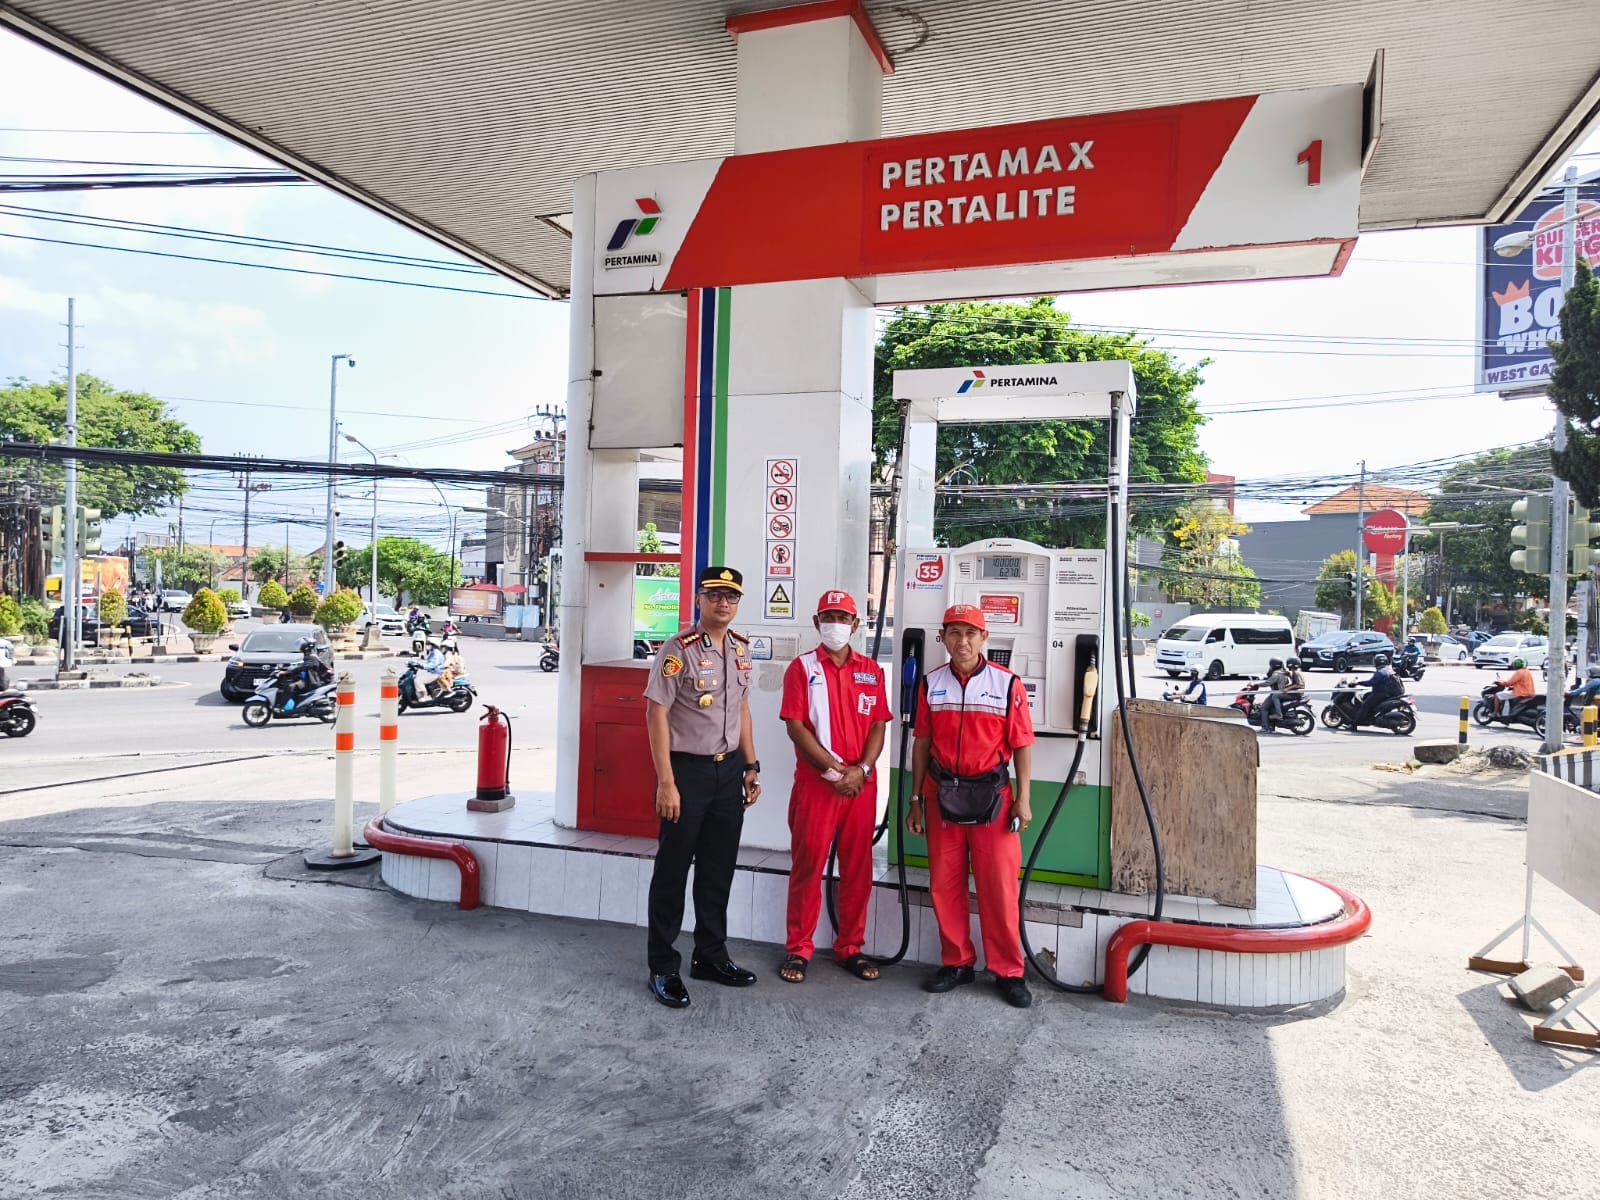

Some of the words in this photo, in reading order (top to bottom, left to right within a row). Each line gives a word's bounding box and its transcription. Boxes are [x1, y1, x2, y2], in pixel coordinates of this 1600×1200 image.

[881, 140, 1095, 190] PERTAMAX
[1297, 139, 1322, 186] 1
[880, 185, 1076, 231] PERTALITE
[1535, 218, 1600, 249] BUER
[604, 253, 658, 267] PERTAMINA
[990, 376, 1058, 388] PERTAMINA
[1487, 366, 1527, 384] WEST
[1052, 640, 1064, 649] 04
